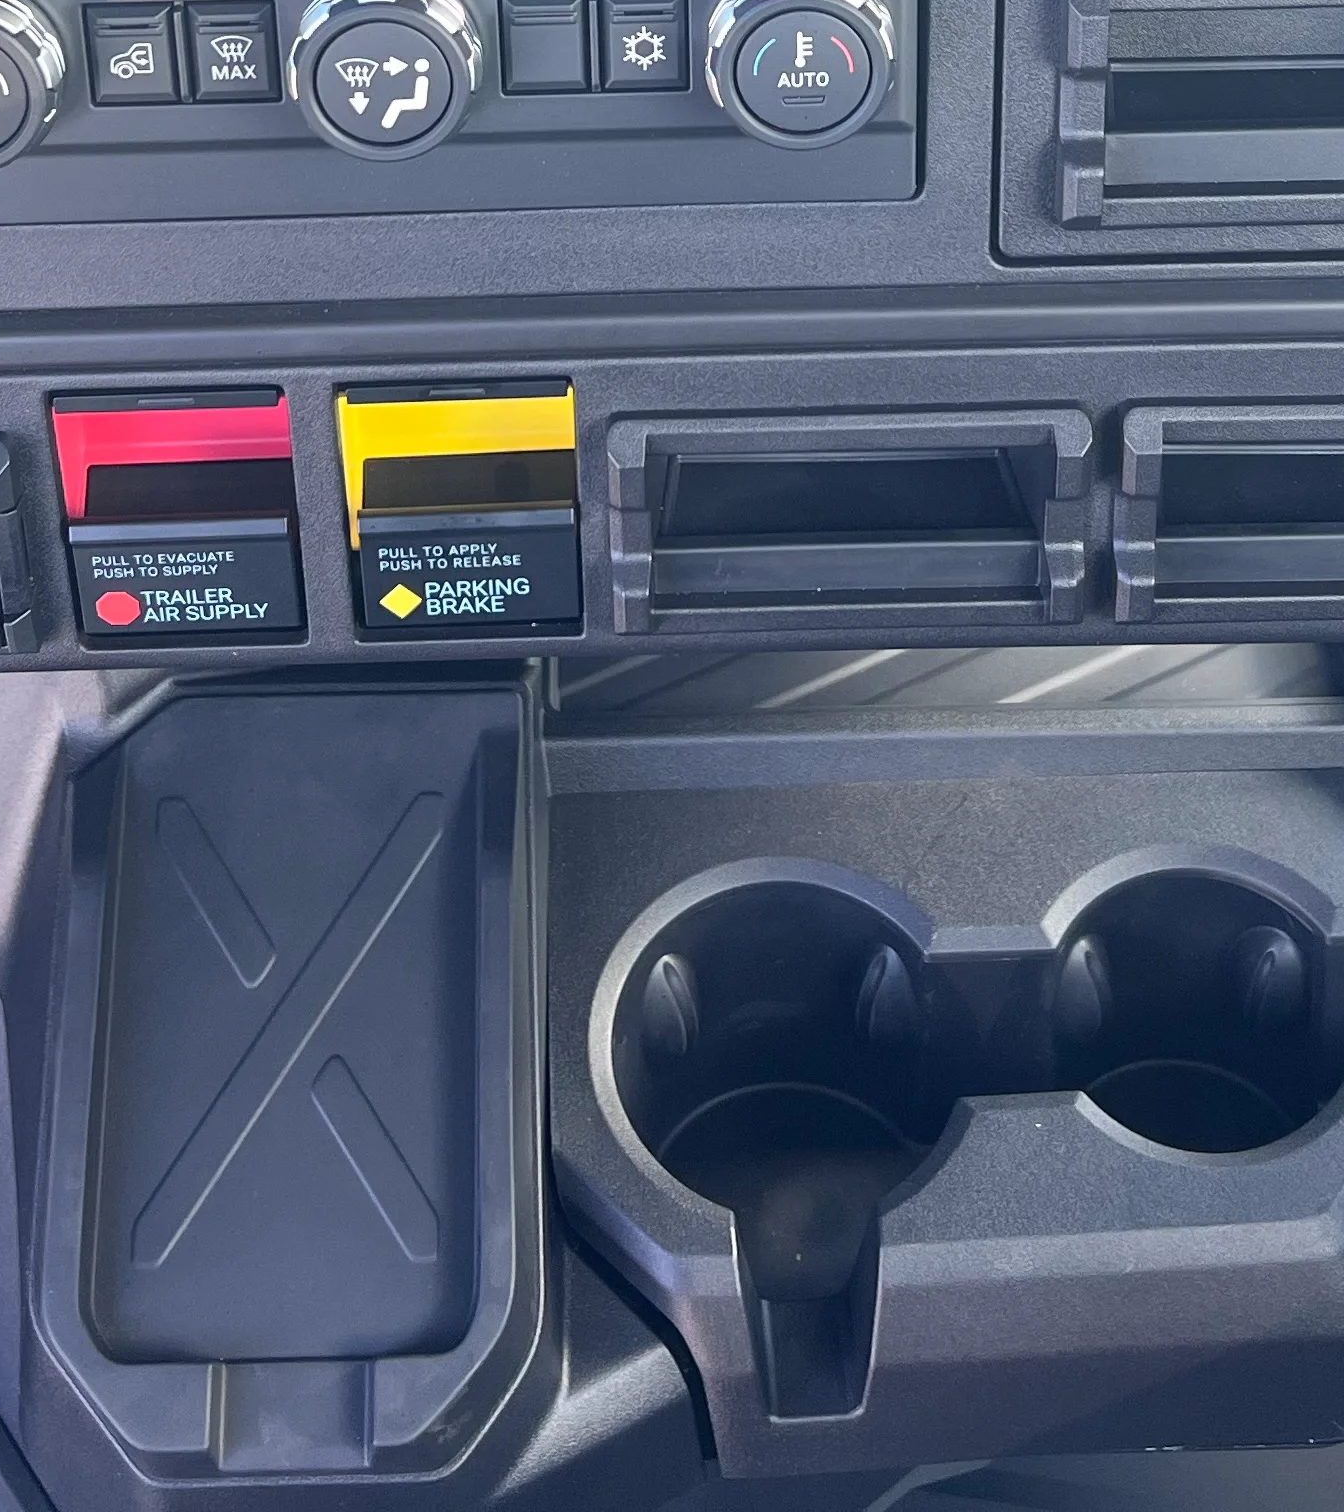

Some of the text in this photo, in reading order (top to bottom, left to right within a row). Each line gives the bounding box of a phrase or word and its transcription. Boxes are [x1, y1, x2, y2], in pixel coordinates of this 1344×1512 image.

[210, 63, 258, 82] MAX
[776, 69, 831, 89] AUTO
[92, 551, 235, 567] PULL TO EVACUATE
[378, 543, 498, 559] PULL TO APPLY
[93, 564, 218, 579] PUSH TO SUPPLY
[379, 554, 522, 572] PUSH TO RELEASE
[140, 588, 234, 606] TRAILER
[424, 577, 531, 599] PARKING
[143, 603, 269, 623] AIR SUPPLY
[425, 595, 506, 616] BRAKE
